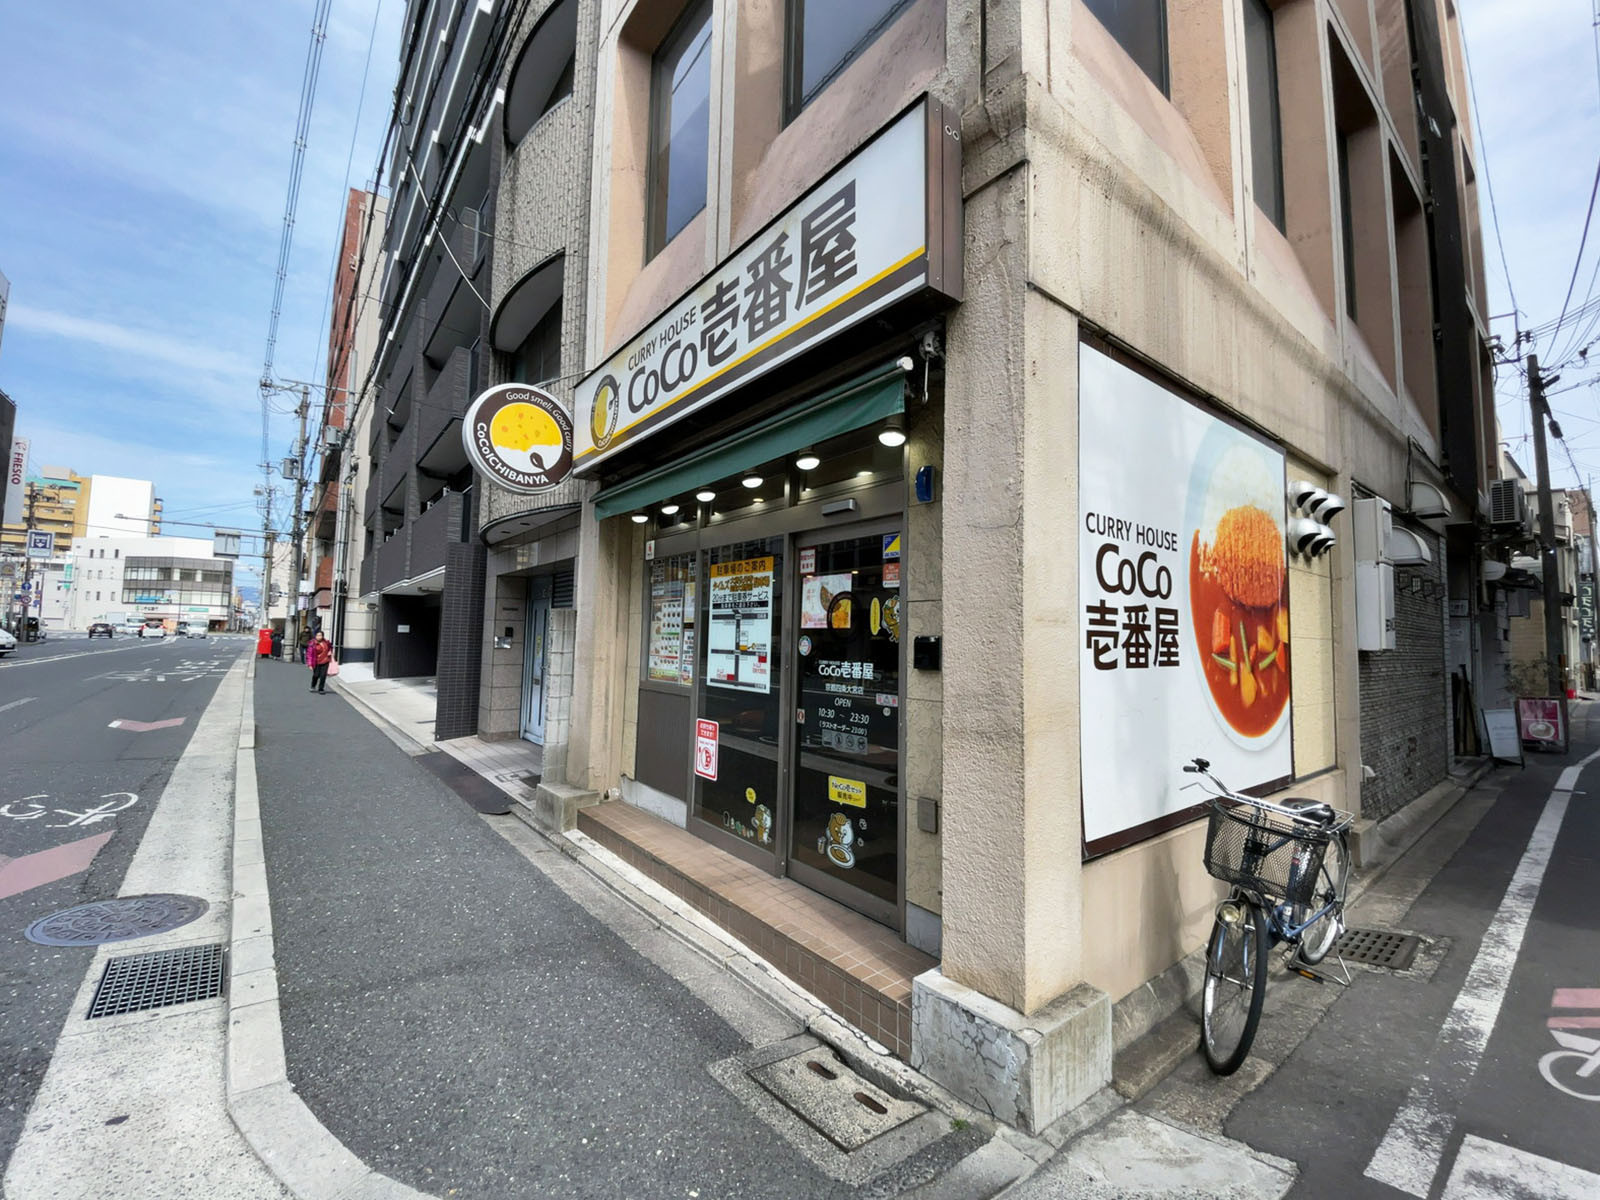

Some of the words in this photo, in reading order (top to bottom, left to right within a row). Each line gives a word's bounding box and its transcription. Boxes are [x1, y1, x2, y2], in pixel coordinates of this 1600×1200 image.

[628, 335, 658, 371] CURRY
[659, 305, 697, 350] HOUSE
[505, 391, 530, 401] Good
[552, 409, 569, 431] Good
[564, 428, 574, 453] curry
[11, 452, 24, 485] FRESCO
[1085, 511, 1133, 542] CURRY
[1136, 525, 1178, 553] HOUSE
[1095, 542, 1173, 600] CoCo
[1085, 599, 1180, 671] 壱番屋
[818, 707, 835, 719] 10:30
[850, 712, 870, 724] 23:30
[834, 697, 852, 708] OPEN
